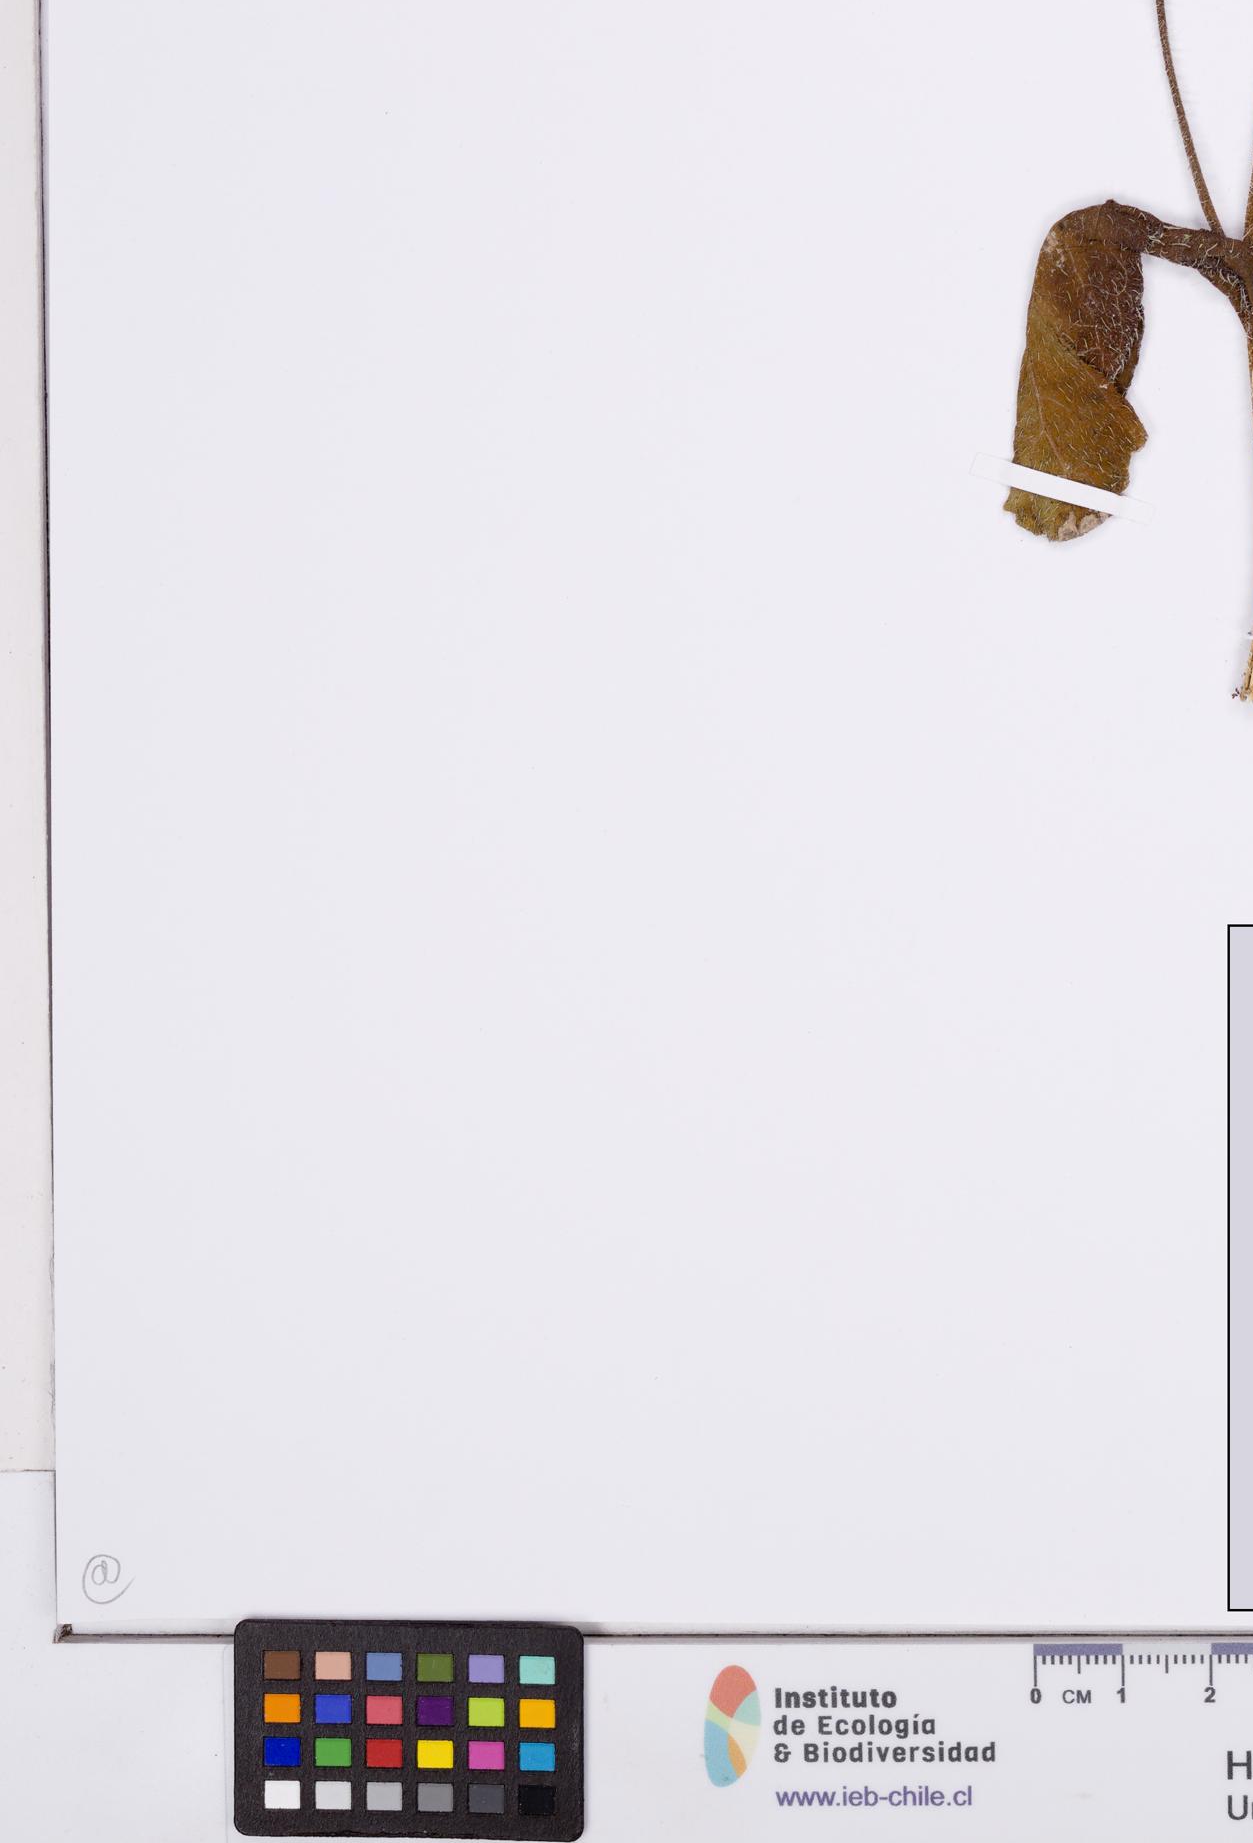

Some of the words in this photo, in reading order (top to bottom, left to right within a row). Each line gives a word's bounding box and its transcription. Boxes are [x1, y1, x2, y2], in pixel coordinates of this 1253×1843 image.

[774, 1685, 898, 1709] Instituto
[1029, 1688, 1042, 1705] 0
[1061, 1689, 1092, 1705] CM
[1116, 1688, 1126, 1704] 1
[1203, 1687, 1217, 1704] 2
[772, 1714, 806, 1736] de
[817, 1713, 936, 1739] Ecología
[773, 1742, 792, 1764] &
[803, 1740, 996, 1764] Biodiversidad
[775, 1785, 973, 1807] www.ieb-chile.cl
